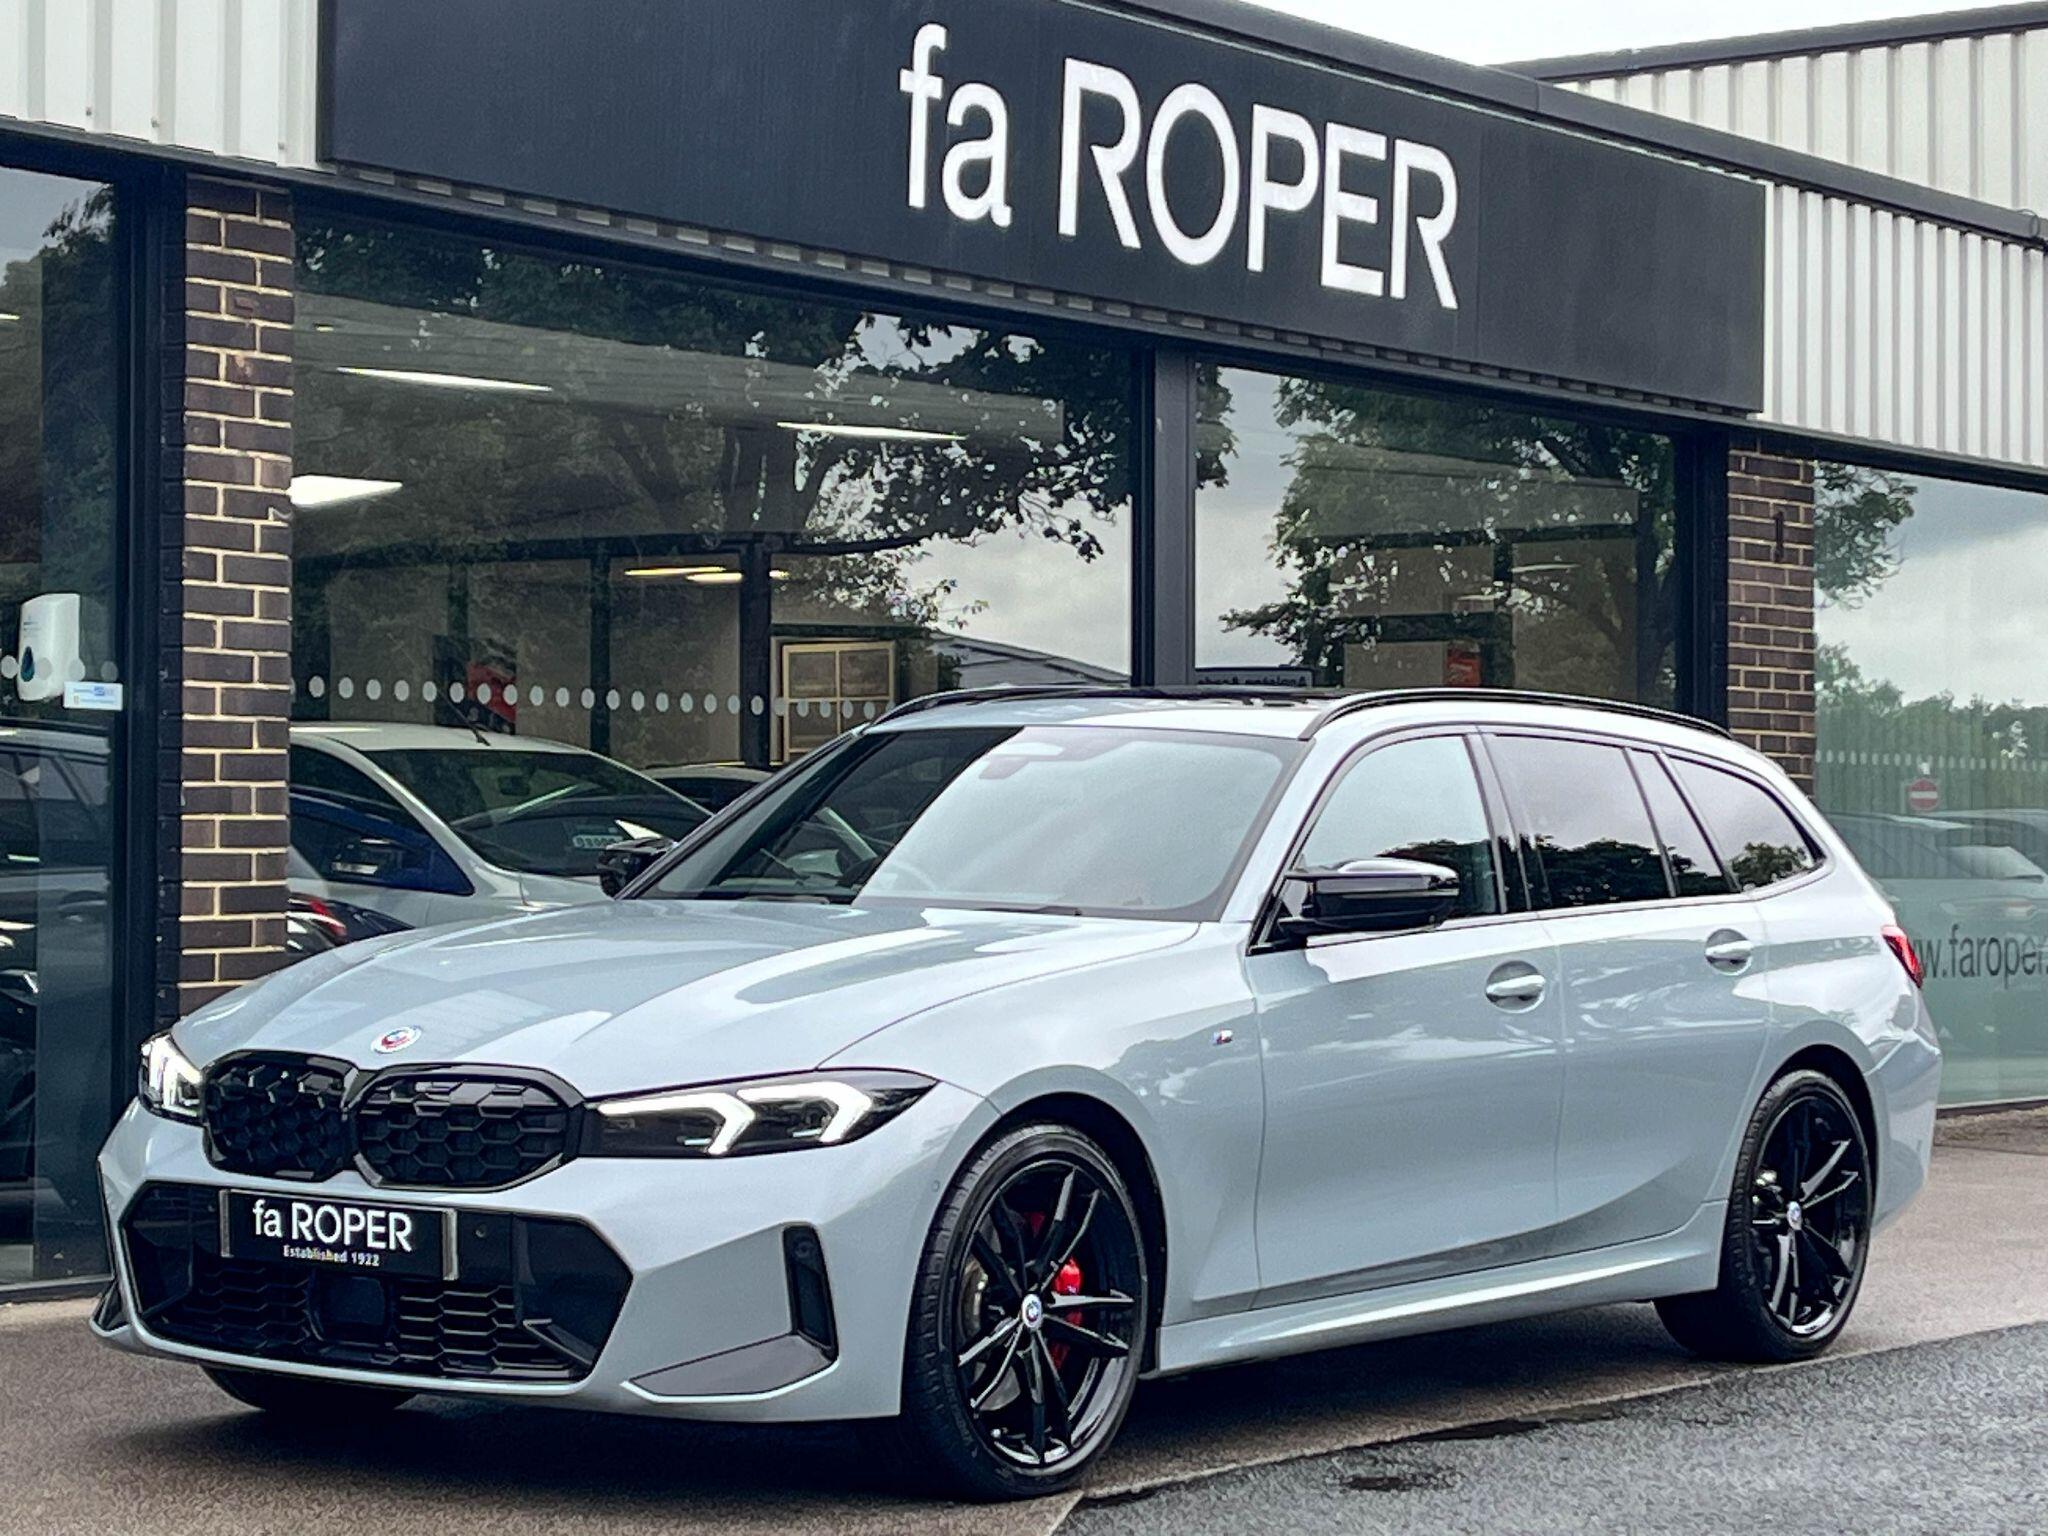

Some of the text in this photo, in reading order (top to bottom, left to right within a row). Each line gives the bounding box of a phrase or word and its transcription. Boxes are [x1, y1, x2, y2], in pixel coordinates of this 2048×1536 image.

[899, 23, 1459, 310] fa ROPER
[252, 1198, 412, 1252] fa ROPER
[283, 1245, 381, 1267] Established 1922
